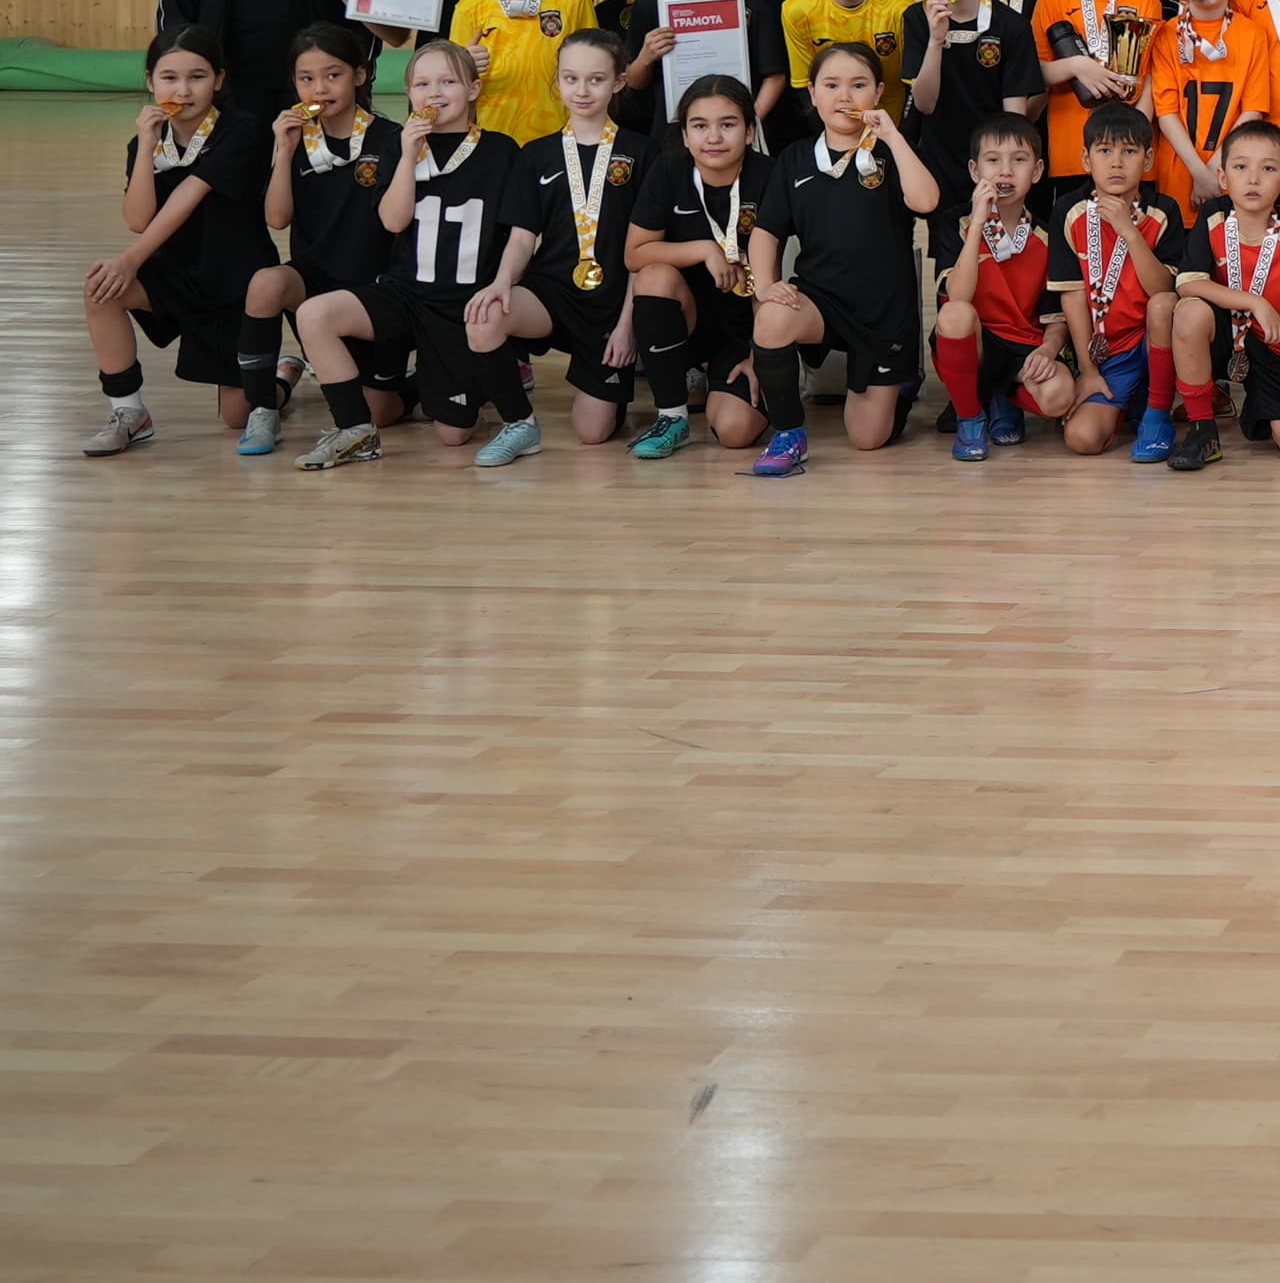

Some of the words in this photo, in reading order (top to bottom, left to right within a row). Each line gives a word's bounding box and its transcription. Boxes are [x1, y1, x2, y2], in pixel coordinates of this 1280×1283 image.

[673, 15, 723, 28] ГРАМОТА
[1183, 79, 1234, 151] 17
[415, 196, 484, 284] 11
